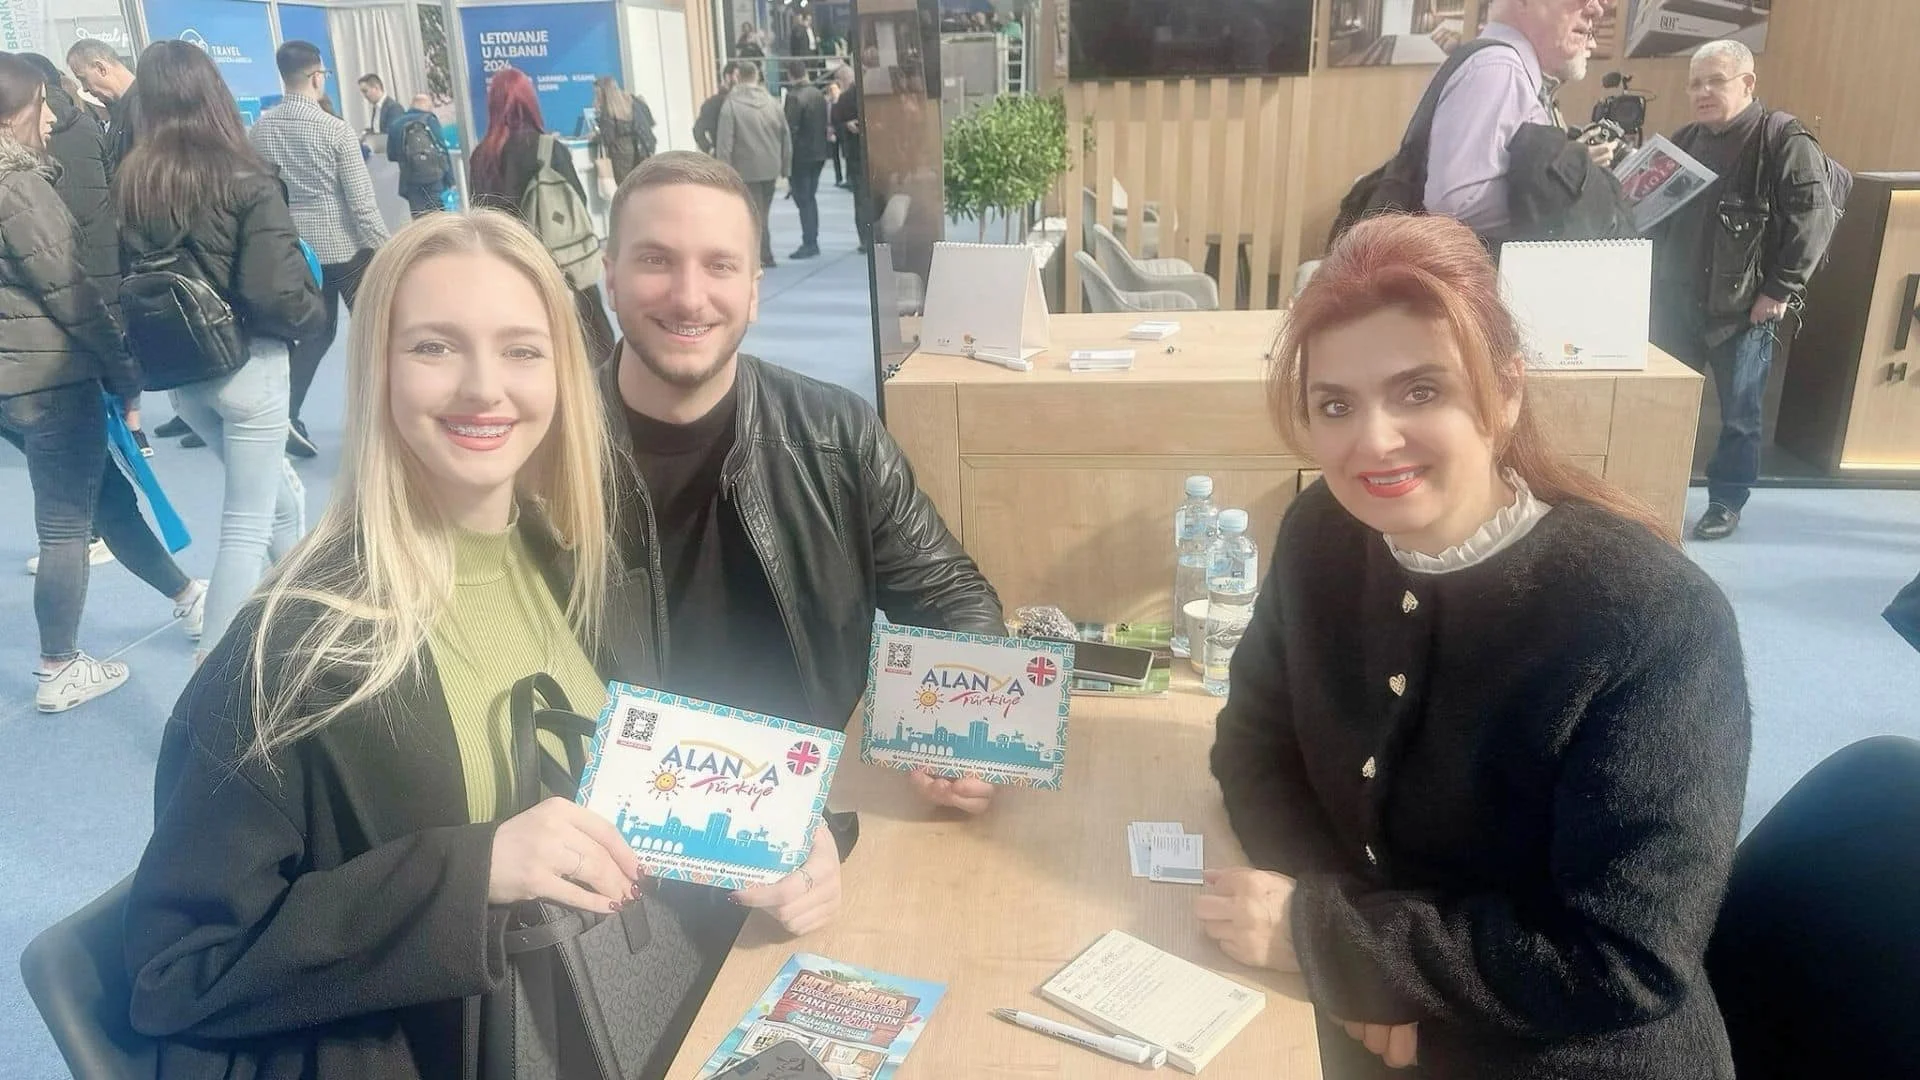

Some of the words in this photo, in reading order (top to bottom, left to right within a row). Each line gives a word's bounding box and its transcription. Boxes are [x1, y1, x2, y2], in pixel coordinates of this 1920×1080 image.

[211, 45, 241, 56] TRAVEL
[479, 30, 549, 45] LETOVANJE
[482, 46, 492, 58] U
[493, 44, 548, 58] ALBANIJI
[483, 59, 512, 72] 2024
[921, 663, 1025, 697] ALANYA
[949, 691, 1021, 718] Türkiye
[661, 739, 780, 787] ALANYA
[690, 775, 775, 812] Türkiye
[798, 974, 833, 992] HIT
[829, 983, 908, 1011] PONUDA
[790, 991, 799, 1000] 7
[798, 994, 826, 1010] DANA
[828, 1001, 852, 1017] PUN
[851, 1008, 901, 1026] PANSION
[799, 1005, 812, 1016] ZA
[814, 1010, 842, 1023] SAMO
